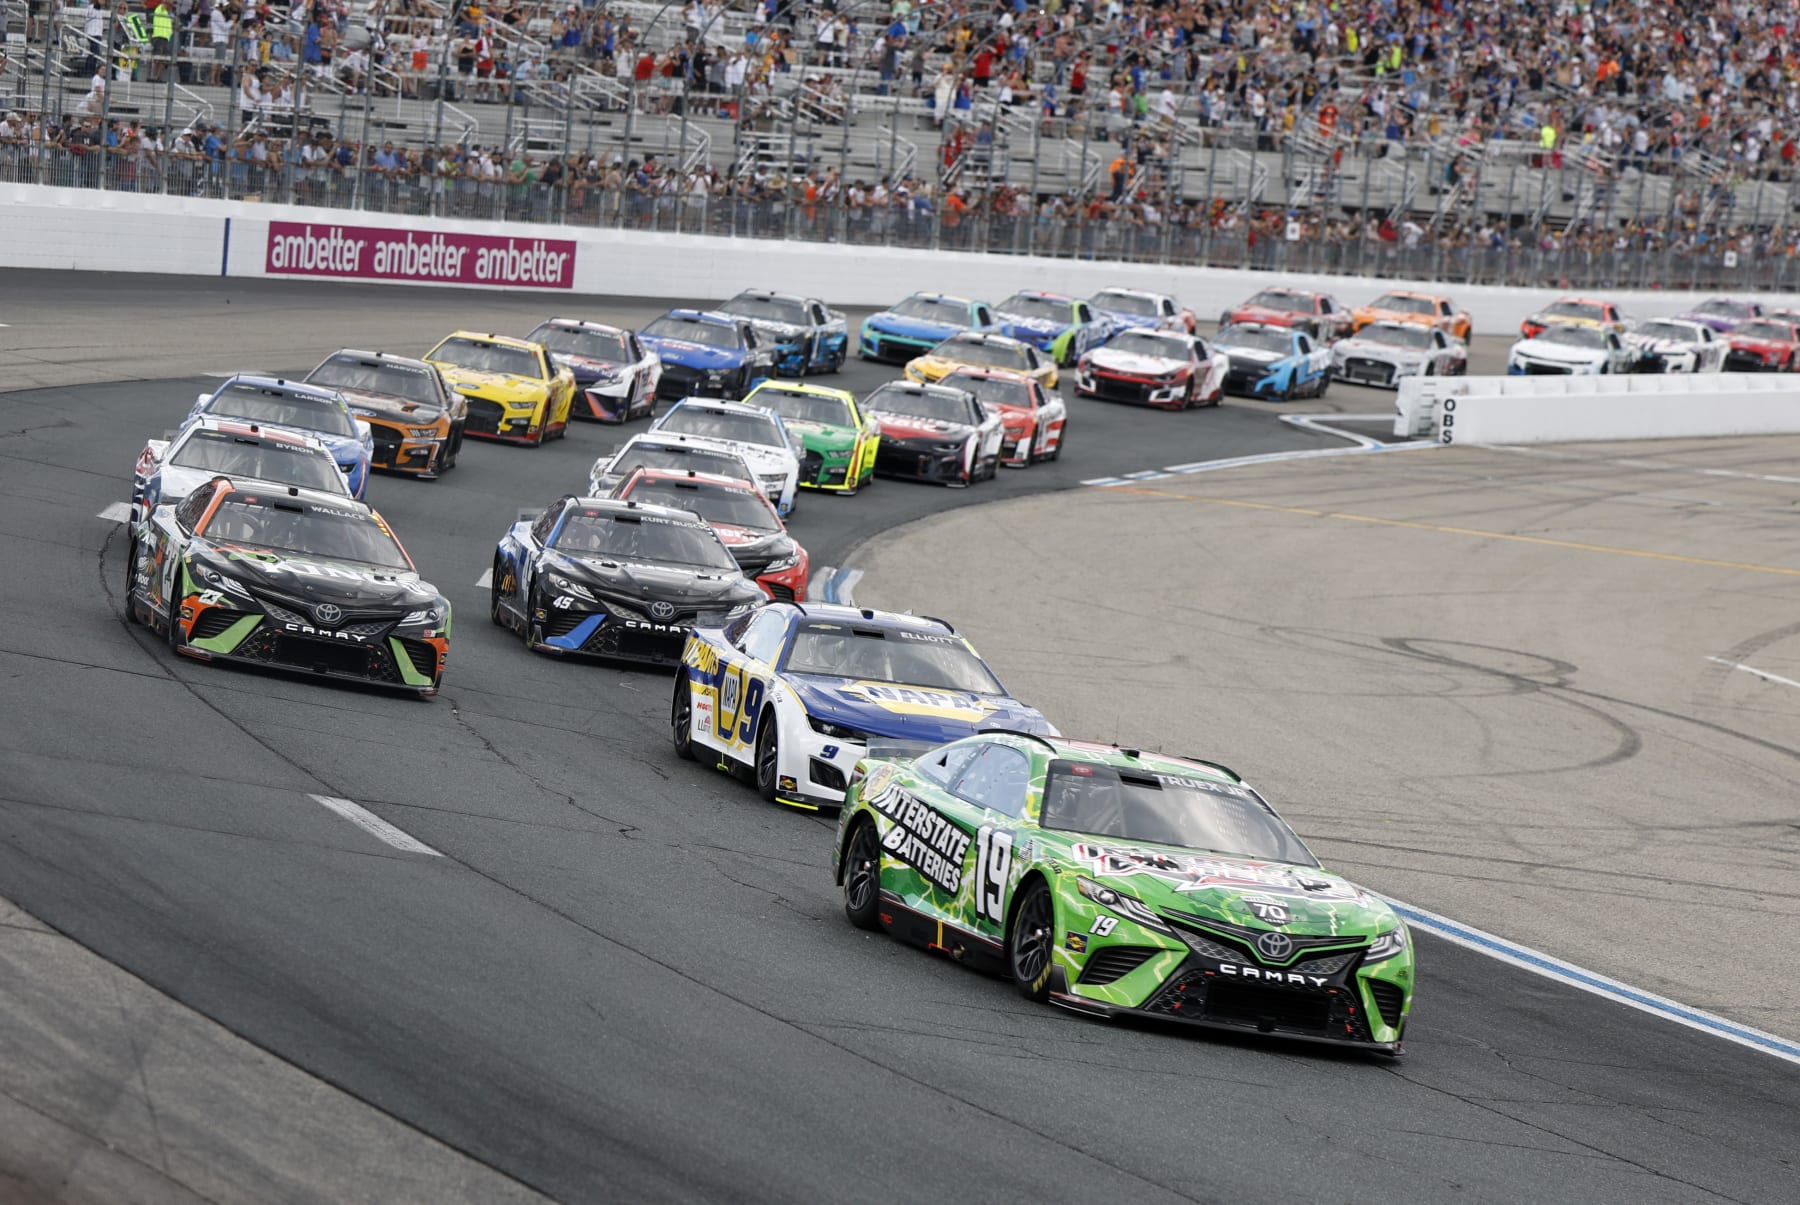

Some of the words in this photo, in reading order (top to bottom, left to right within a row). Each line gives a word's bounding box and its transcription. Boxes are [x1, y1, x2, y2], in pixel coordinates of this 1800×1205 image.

[271, 225, 364, 272] ambetter
[373, 232, 466, 278] ambetter
[475, 239, 567, 283] ambetter
[276, 442, 314, 455] BYRON
[311, 505, 366, 520] WALLACE
[641, 516, 669, 525] KURT
[199, 589, 223, 605] 23
[553, 596, 575, 609] 45
[286, 623, 367, 641] CAMRY
[900, 631, 953, 645] ELLIOTT
[866, 686, 982, 711] NAPA
[739, 677, 765, 745] 9
[820, 744, 840, 759] 9
[1152, 774, 1222, 793] TRUEX
[870, 783, 971, 866] INTERSTATE
[882, 825, 961, 894] BATTERIES
[976, 825, 1012, 923] 19
[1253, 902, 1287, 920] 70
[1089, 914, 1119, 937] 19
[1220, 964, 1328, 987] CAMRY
